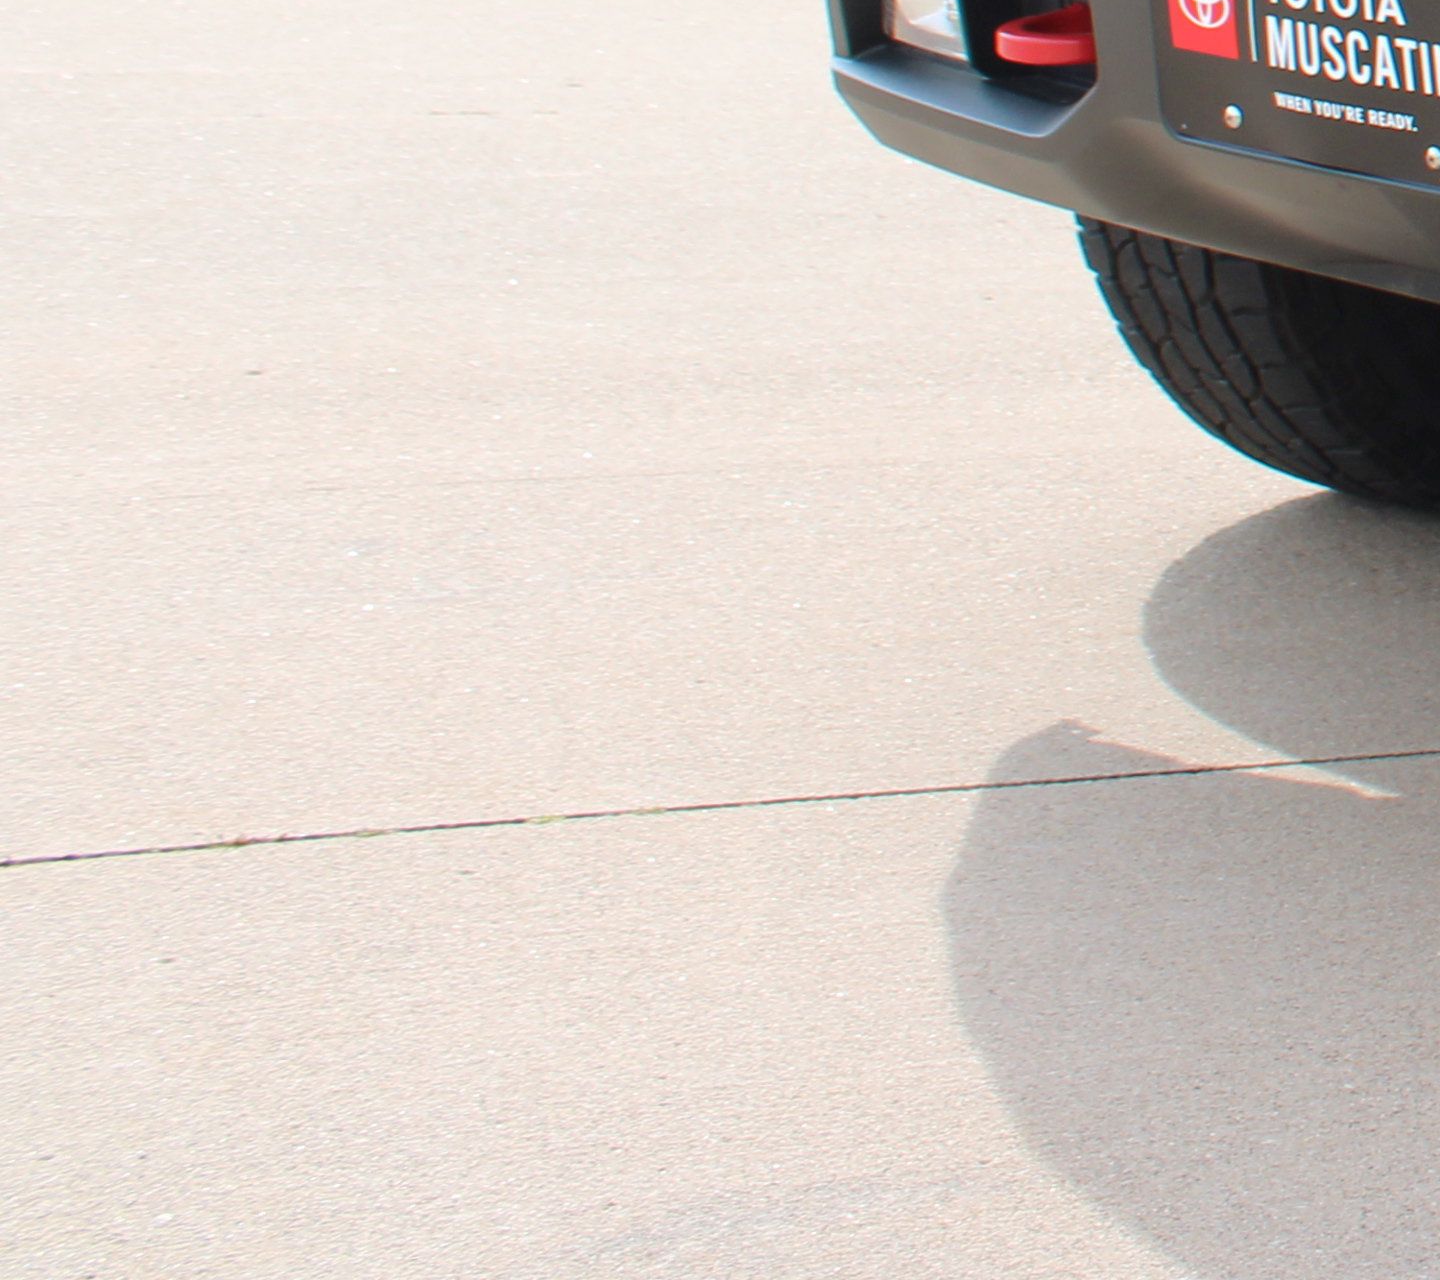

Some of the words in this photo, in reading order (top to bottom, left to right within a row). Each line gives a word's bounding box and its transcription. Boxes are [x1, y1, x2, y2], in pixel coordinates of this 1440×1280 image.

[1273, 91, 1313, 116] WHEN
[1313, 98, 1365, 124] YOU'RE
[1367, 108, 1420, 133] READY.
